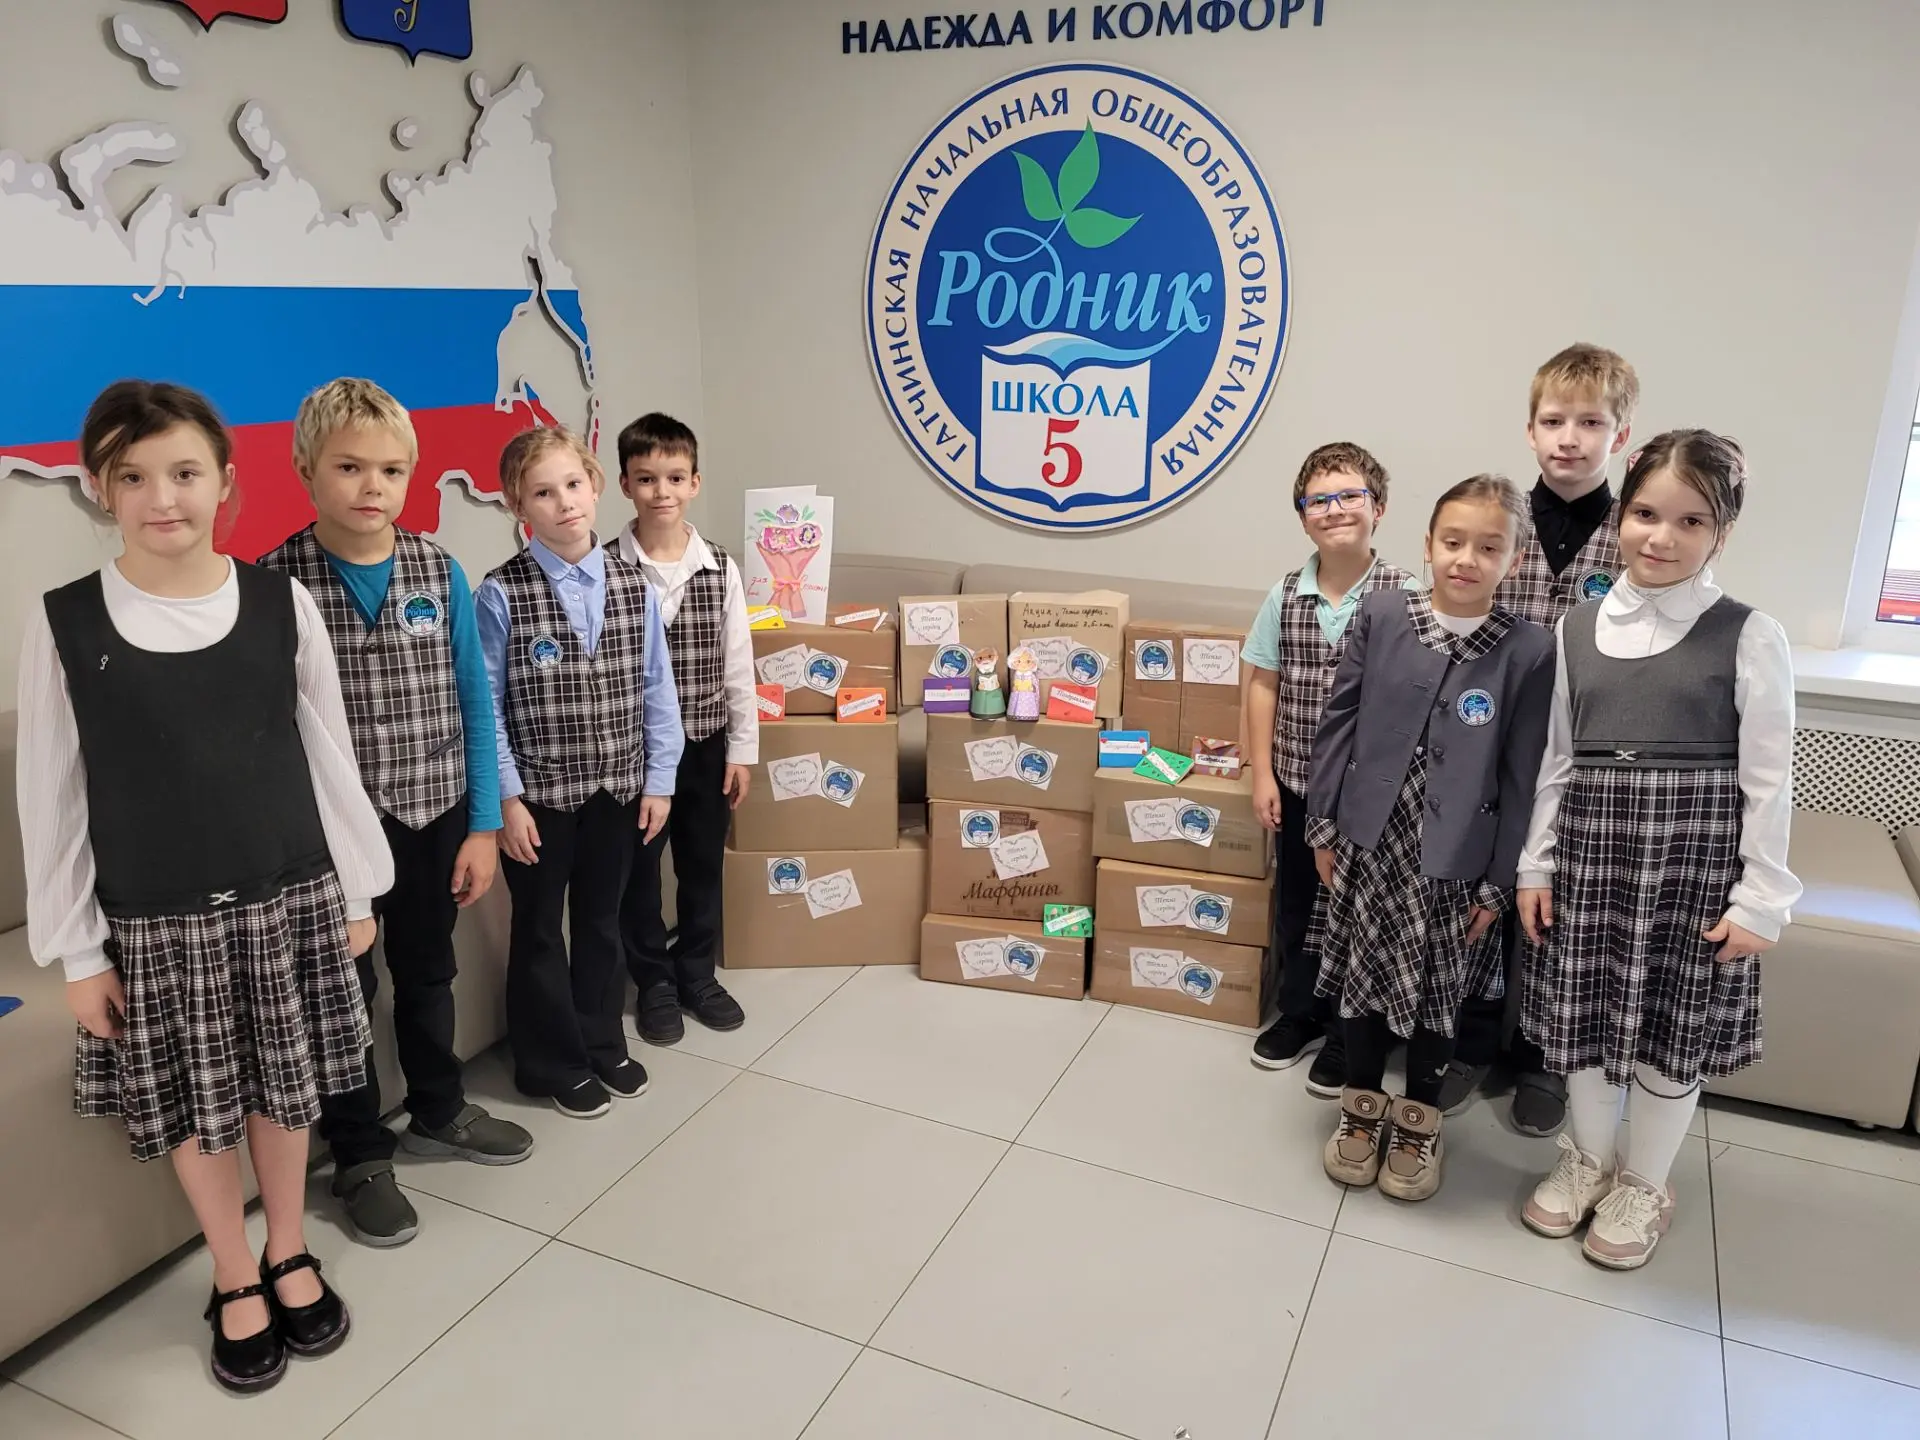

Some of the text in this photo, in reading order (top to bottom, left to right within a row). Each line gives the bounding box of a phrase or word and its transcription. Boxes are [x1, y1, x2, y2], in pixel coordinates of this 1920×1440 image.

[842, 10, 1034, 54] НАДЕЖДА
[1049, 8, 1076, 42] И
[884, 87, 1268, 476] ГАТЧИНСКАЯ НАЧАЛЬНАЯ ОБЩЕОБРАЗОВАТЕЛЬНАЯ
[926, 226, 1213, 334] Родник
[991, 379, 1140, 418] ШКОЛА
[1041, 418, 1083, 488] 5
[962, 881, 1061, 905] Маффины
